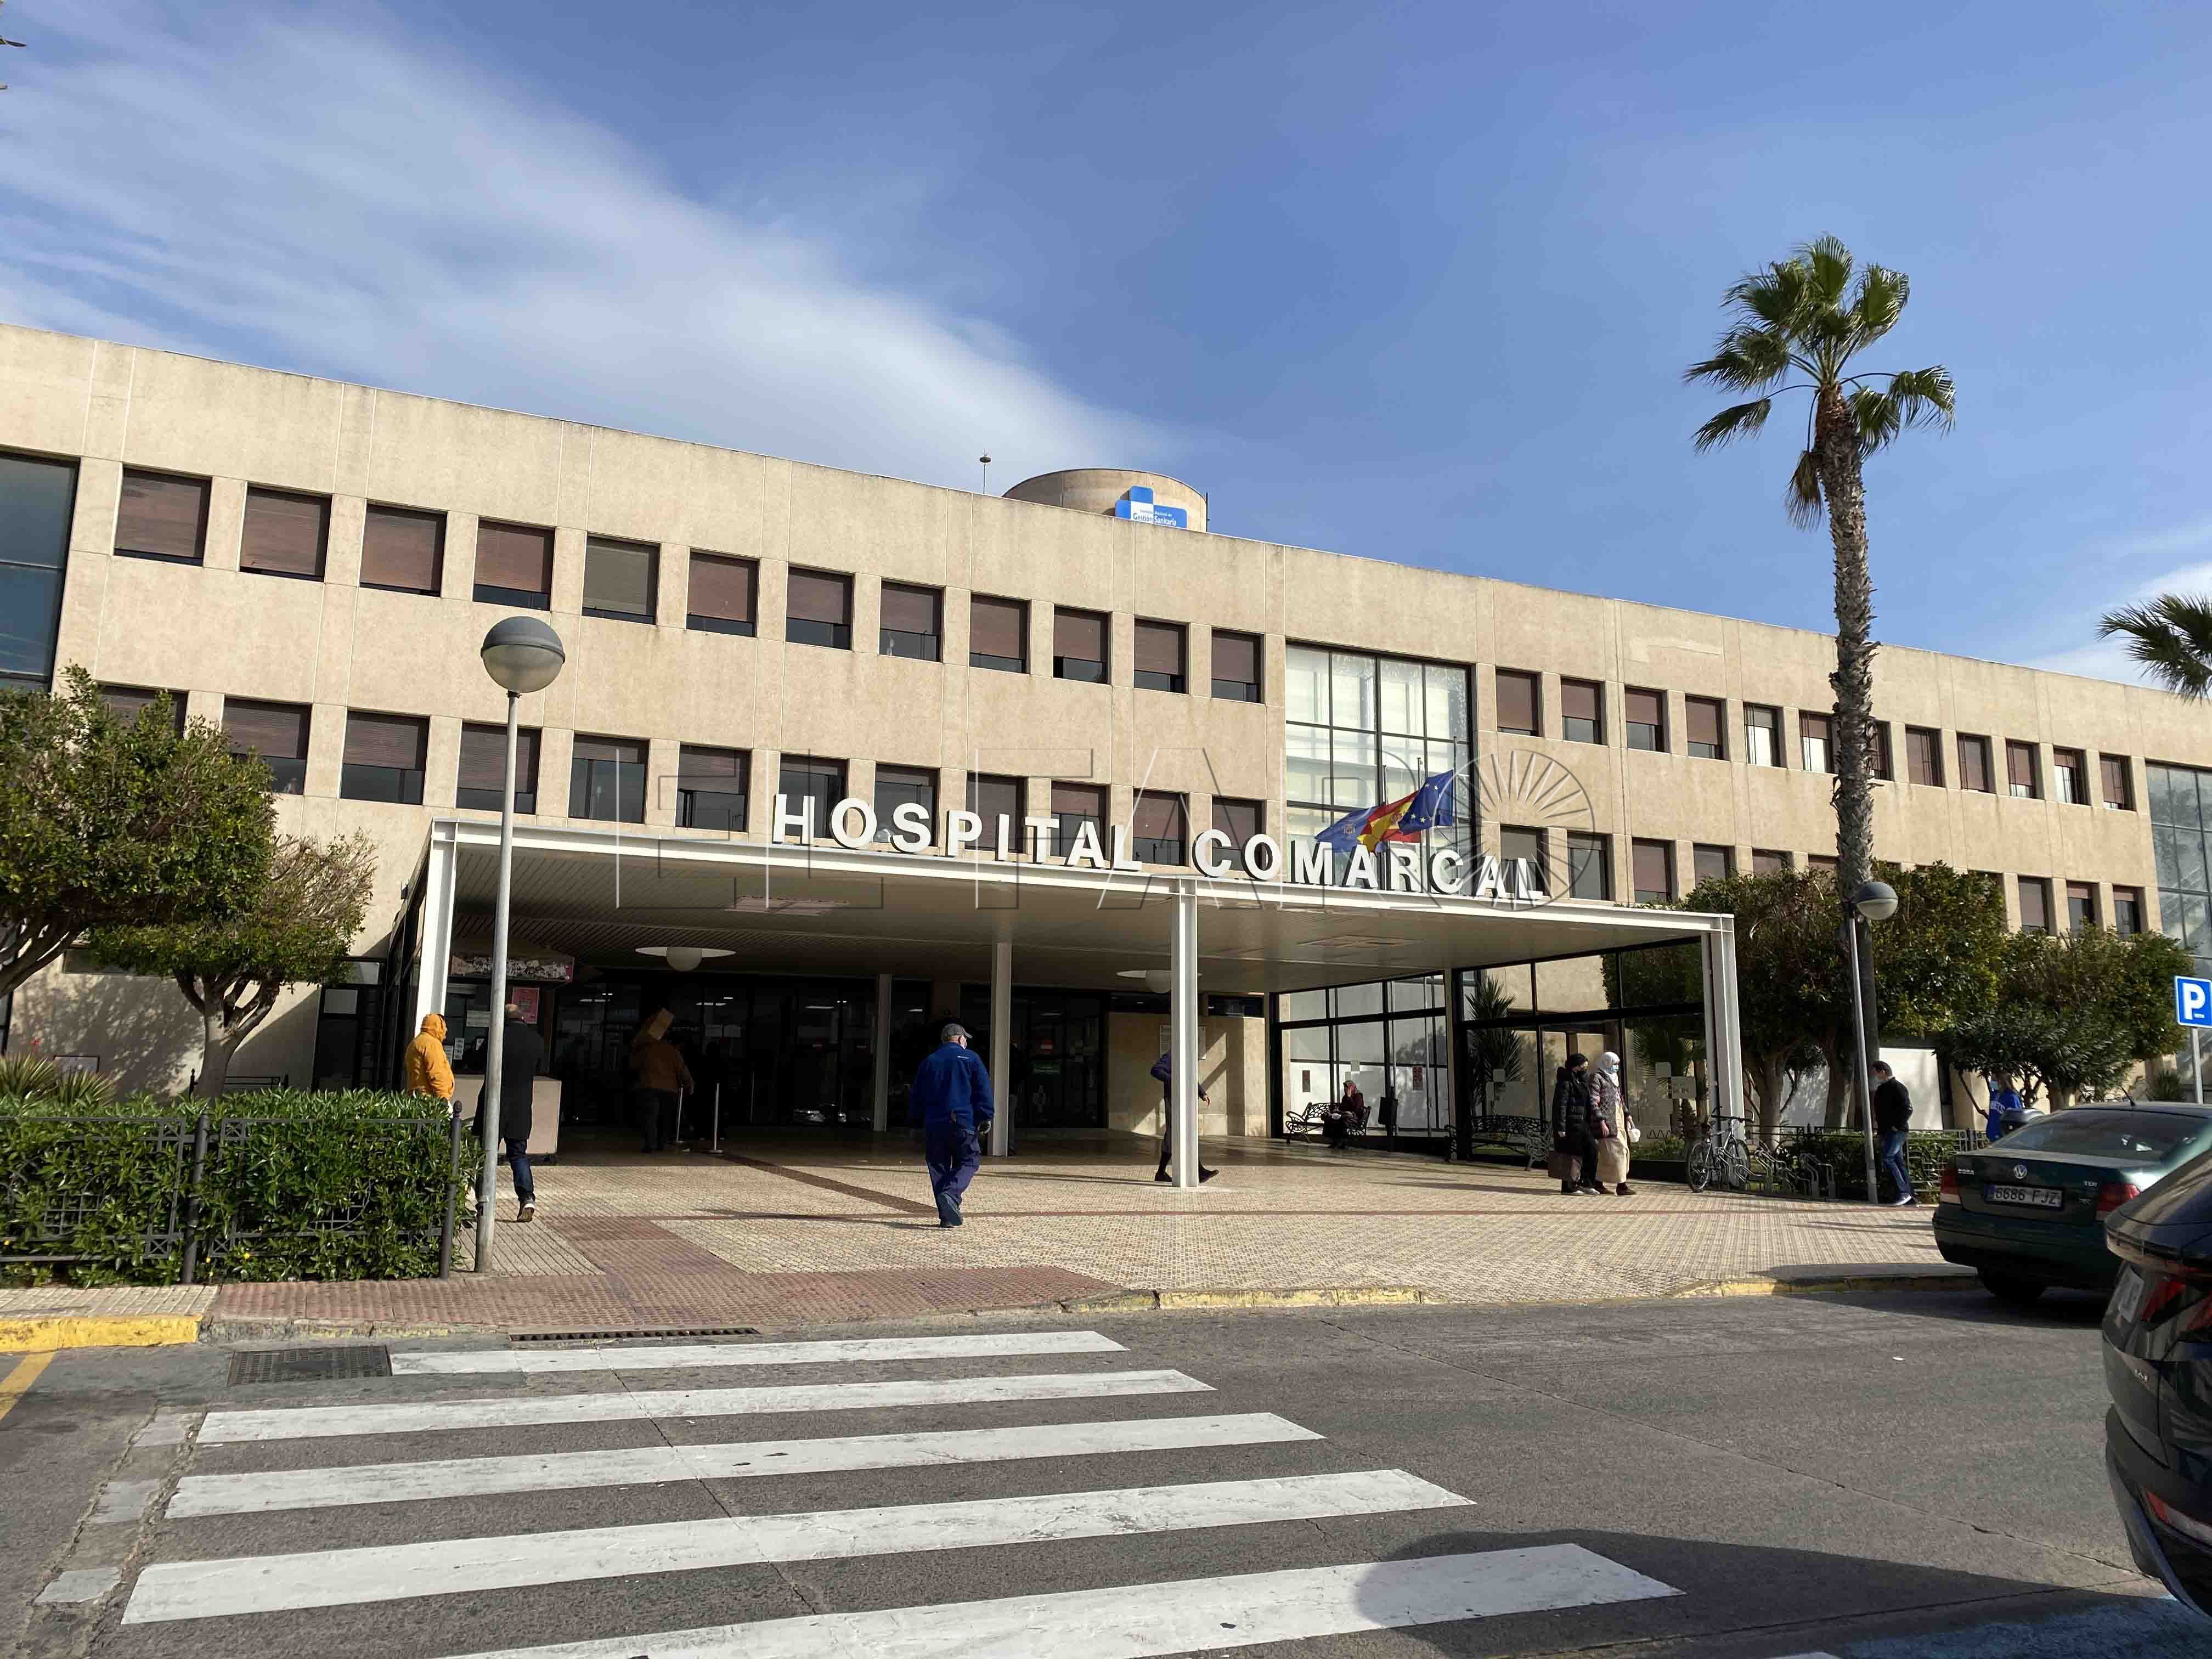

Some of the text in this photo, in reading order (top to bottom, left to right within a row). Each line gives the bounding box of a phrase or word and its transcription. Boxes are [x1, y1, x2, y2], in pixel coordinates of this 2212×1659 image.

[1133, 512, 1153, 523] Gestión
[1154, 515, 1177, 527] Sanitaria
[772, 793, 1544, 900] HOSPITAL COMARCAL
[2183, 983, 2206, 1020] P
[2032, 1189, 2059, 1205] FJZ
